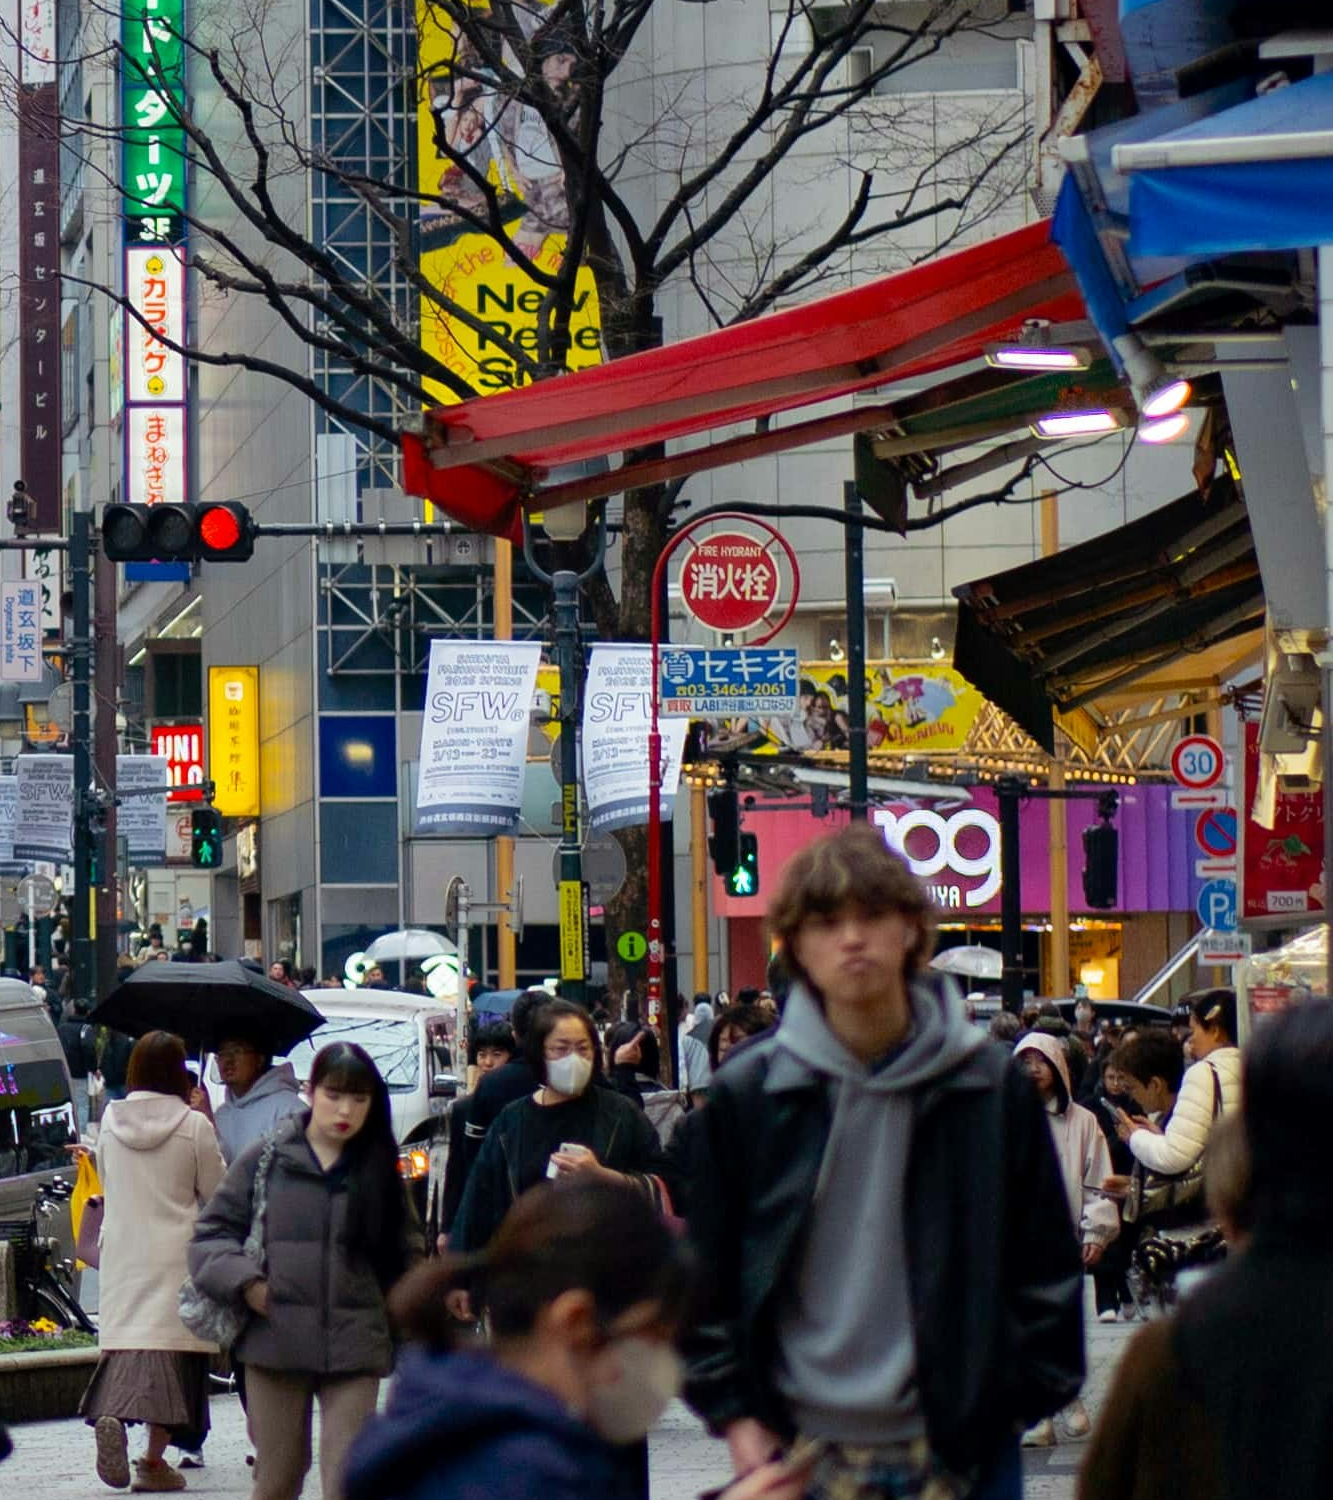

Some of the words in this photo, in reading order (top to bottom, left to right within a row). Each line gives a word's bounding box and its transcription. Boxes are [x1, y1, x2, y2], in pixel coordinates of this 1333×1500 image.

[139, 217, 170, 242] 3F
[33, 166, 48, 441] 道玄坂センタービル
[698, 545, 719, 558] FIRE
[720, 546, 763, 558] HYDRANT
[689, 562, 772, 601] 消火栓
[17, 588, 37, 674] 道玄坂下
[698, 650, 797, 684] セキネ
[157, 733, 199, 762] UNI
[1183, 750, 1213, 776] 30
[1209, 893, 1231, 927] P
